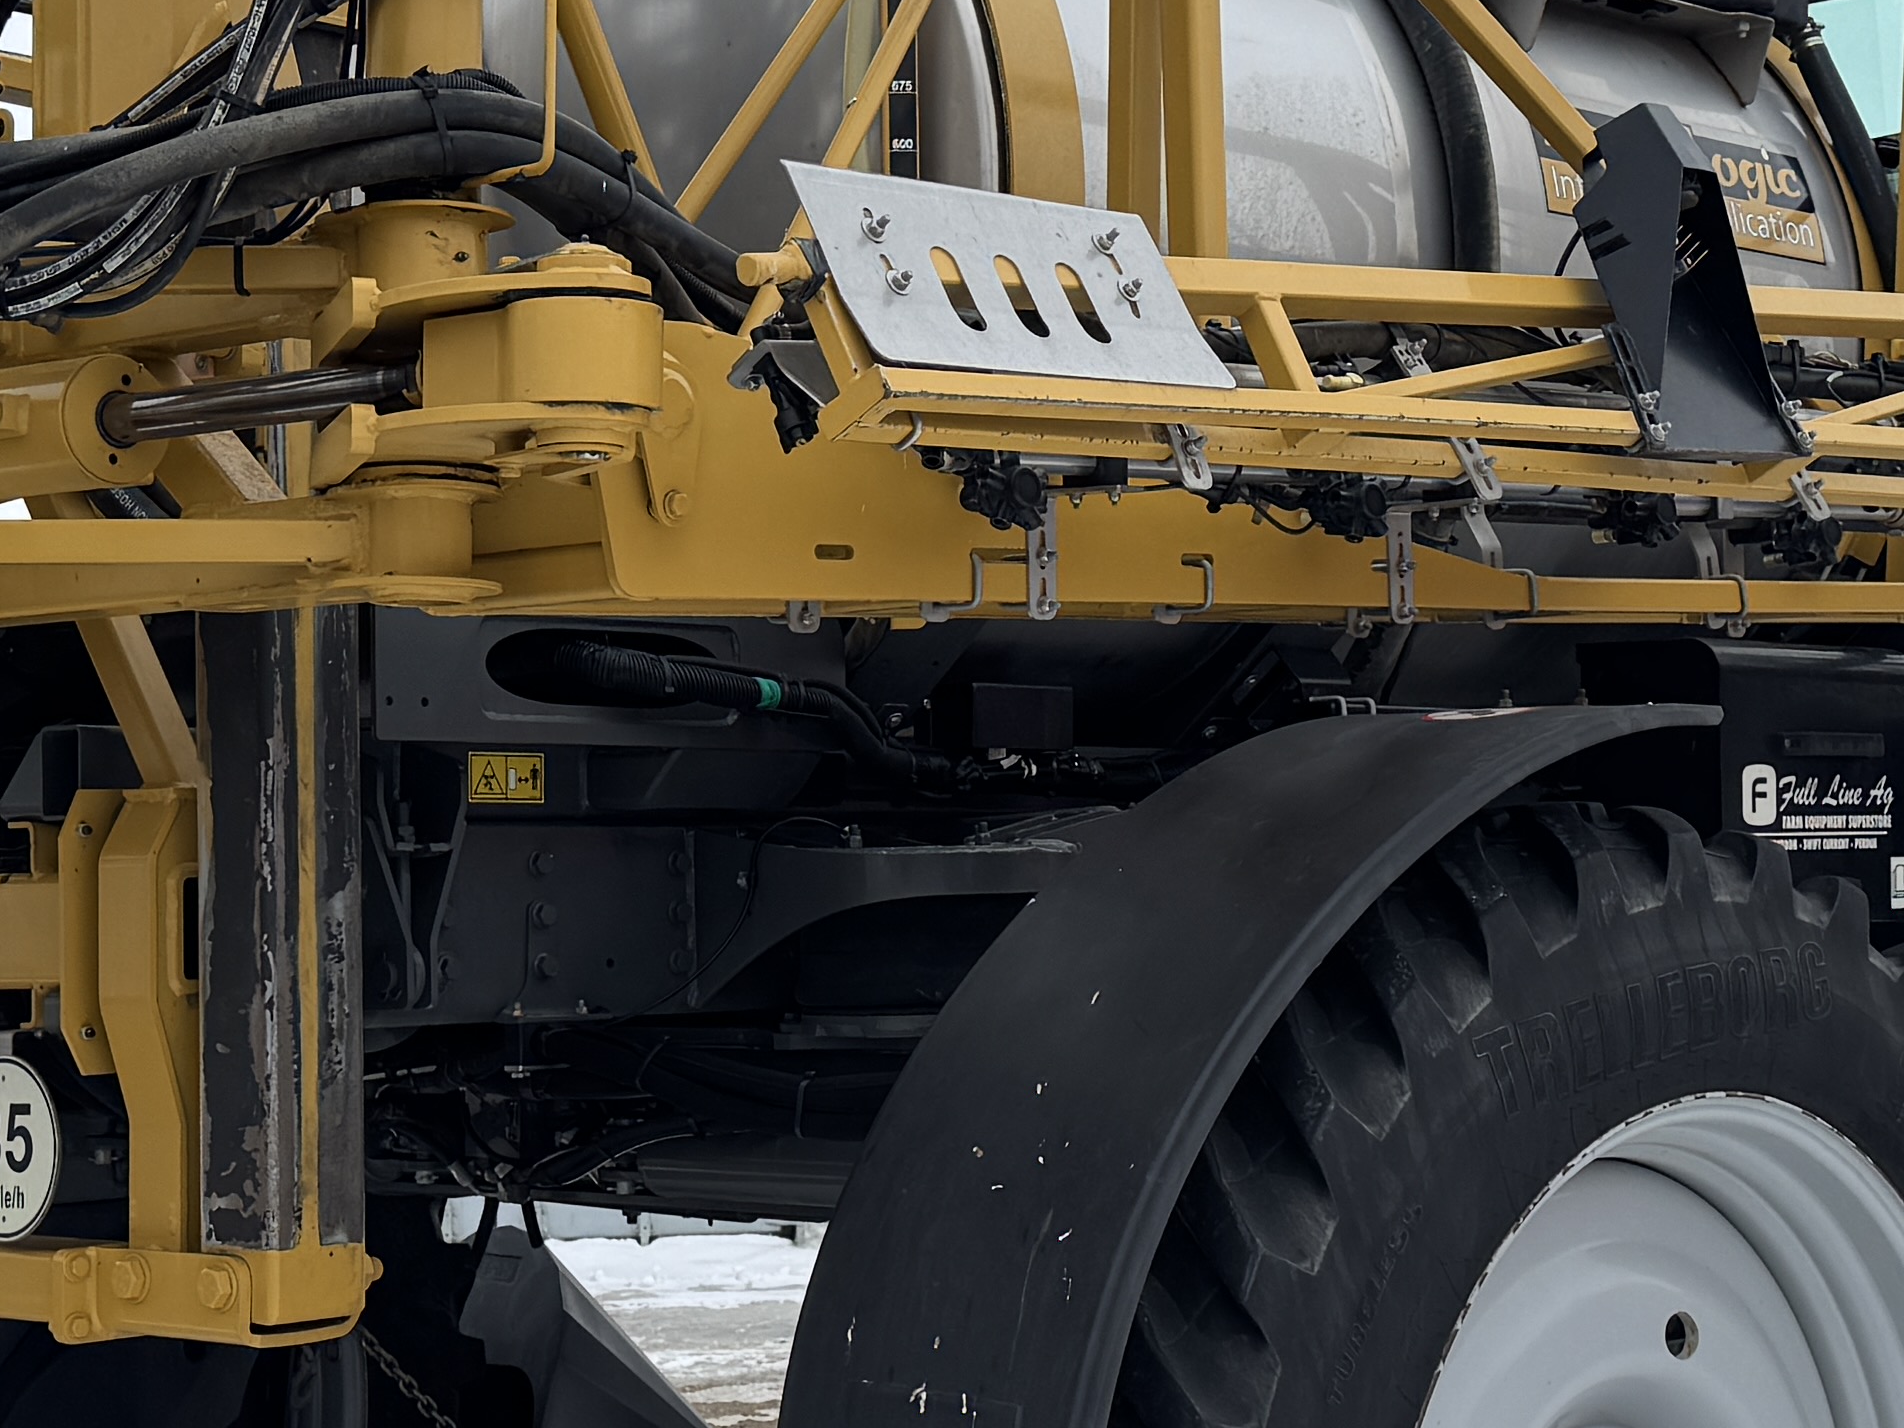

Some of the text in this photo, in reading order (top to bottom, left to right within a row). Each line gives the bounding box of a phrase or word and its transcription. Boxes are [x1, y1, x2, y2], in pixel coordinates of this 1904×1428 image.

[1709, 145, 1802, 207] ogic
[1726, 199, 1816, 248] lication
[1778, 773, 1895, 815] Full Line Ag
[1782, 814, 1893, 830] FARM EQUIPMENT SUPERSTORE
[1470, 939, 1835, 1123] TRELLEBORG
